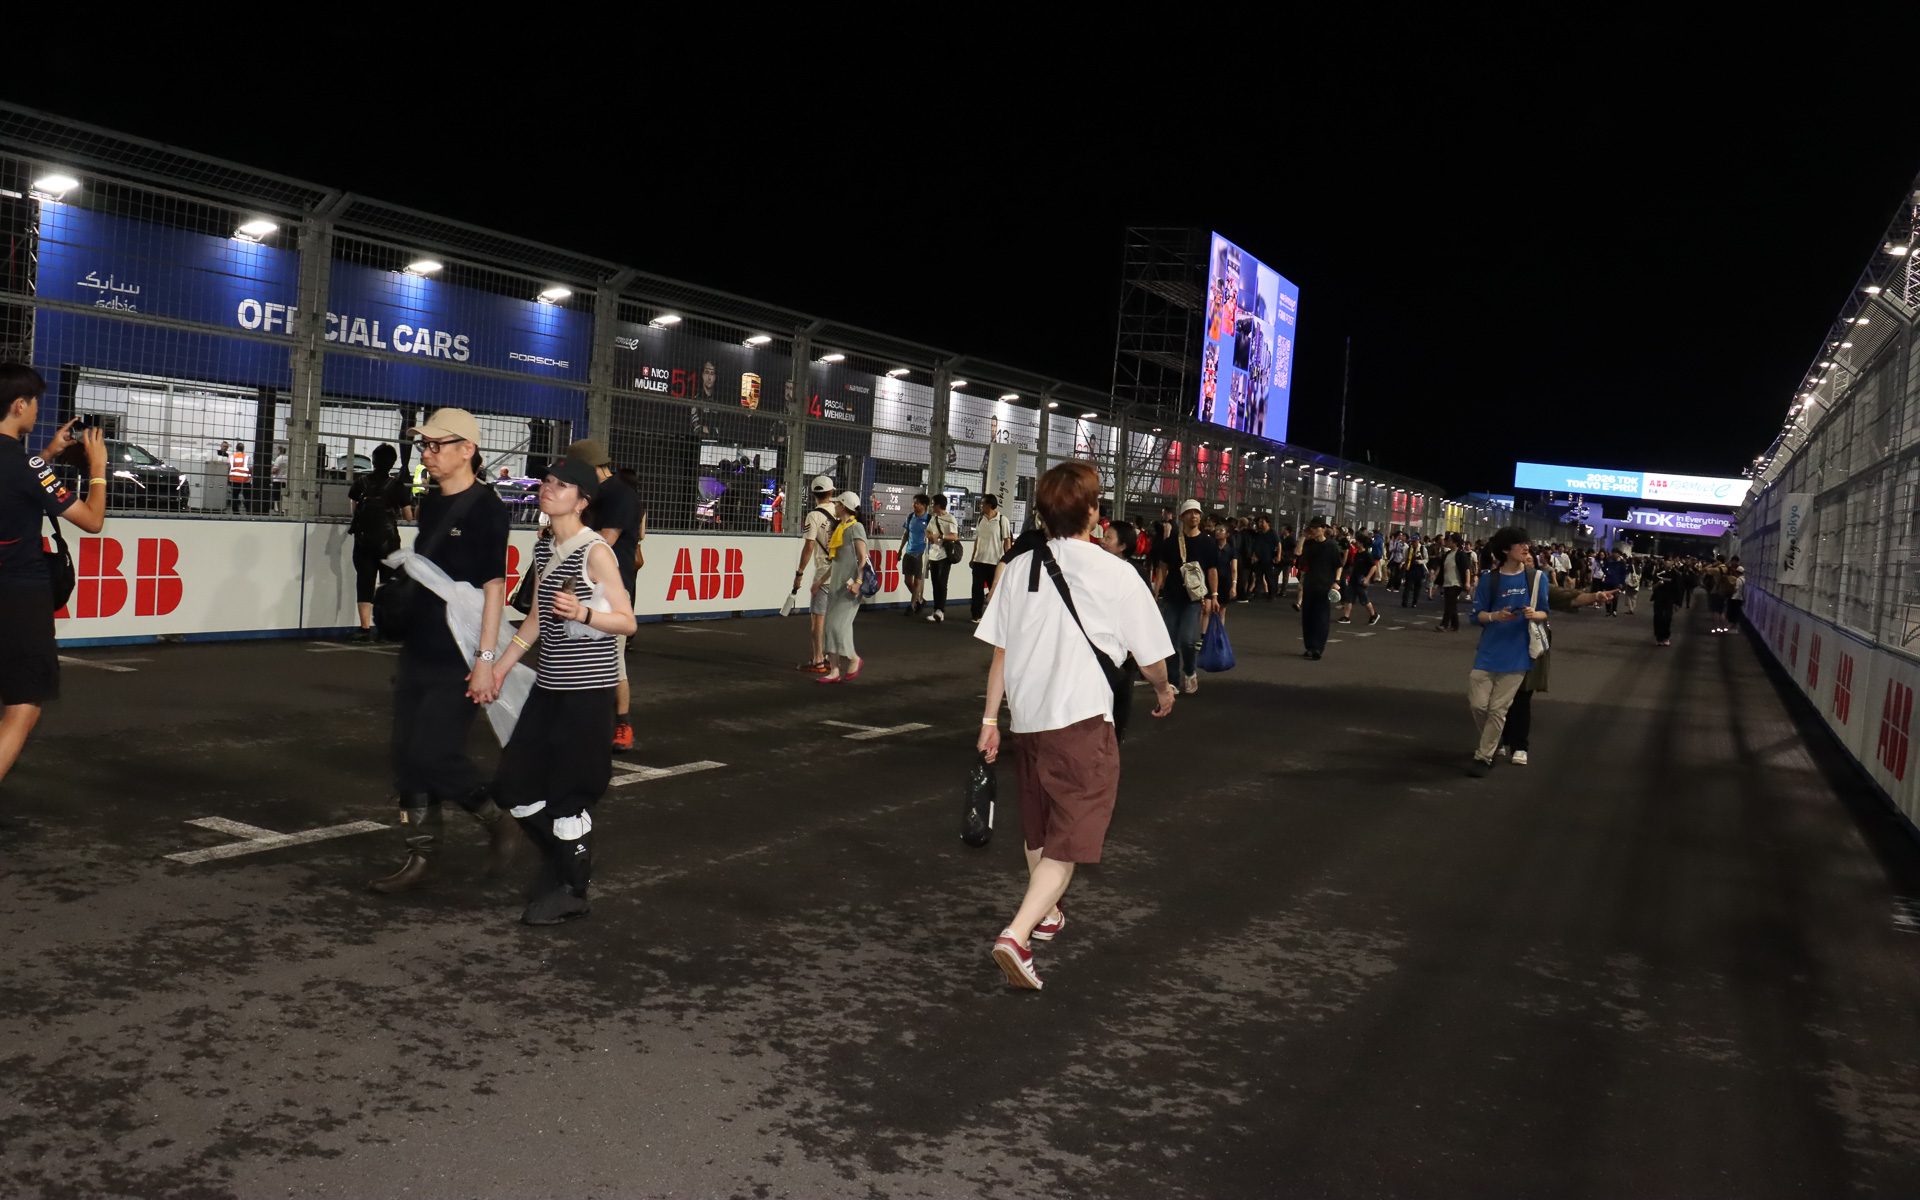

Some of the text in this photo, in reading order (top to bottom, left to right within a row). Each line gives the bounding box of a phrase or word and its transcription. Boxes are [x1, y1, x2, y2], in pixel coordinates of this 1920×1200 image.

[392, 324, 470, 362] CARS
[509, 352, 569, 368] PORSCHE
[651, 367, 670, 379] NICO
[634, 377, 668, 393] MÜLLER
[671, 369, 698, 398] 51
[824, 400, 845, 410] PASCAL
[824, 409, 855, 421] WEHRLEIN
[910, 424, 927, 433] EVANS
[1566, 479, 1638, 493] TOKYO E-PRIX
[1587, 473, 1639, 485] 2026 TDK
[1649, 480, 1668, 488] ABB
[1669, 480, 1716, 492] FORMULA
[1633, 511, 1676, 527] TDK
[1676, 521, 1702, 530] Better
[1787, 505, 1800, 538] Tokyo
[43, 538, 183, 619] BB
[666, 548, 744, 601] ABB
[1832, 651, 1853, 726] ABB
[1877, 678, 1913, 782] ABB
